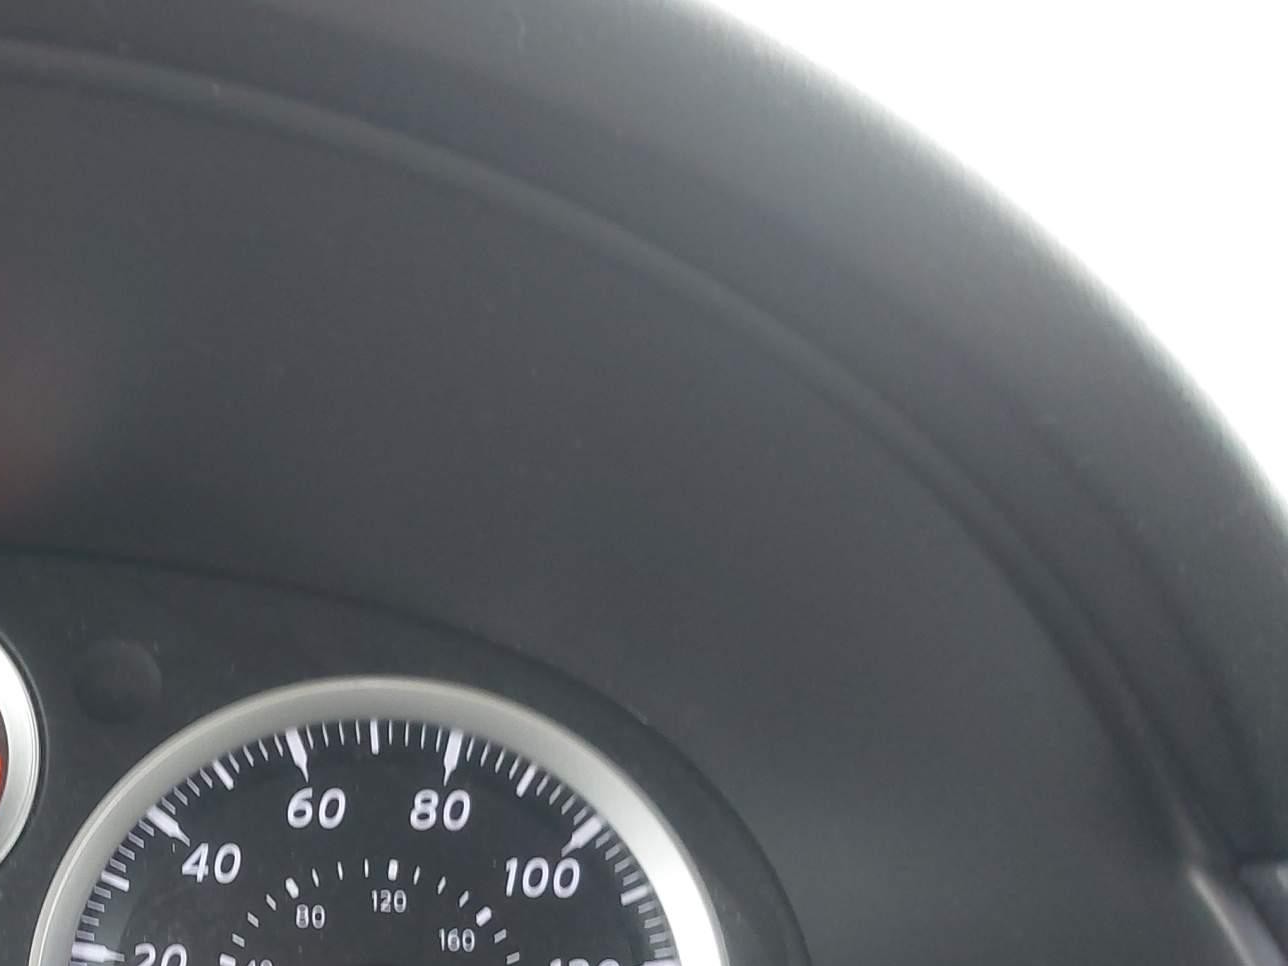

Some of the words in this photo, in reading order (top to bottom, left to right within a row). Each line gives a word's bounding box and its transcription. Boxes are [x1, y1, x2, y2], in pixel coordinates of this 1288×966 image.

[287, 787, 346, 829] 60
[410, 787, 471, 831] 80
[180, 841, 242, 884] 40
[505, 855, 581, 899] 100
[295, 904, 326, 929] 80
[371, 889, 407, 913] 120
[438, 928, 476, 952] 160
